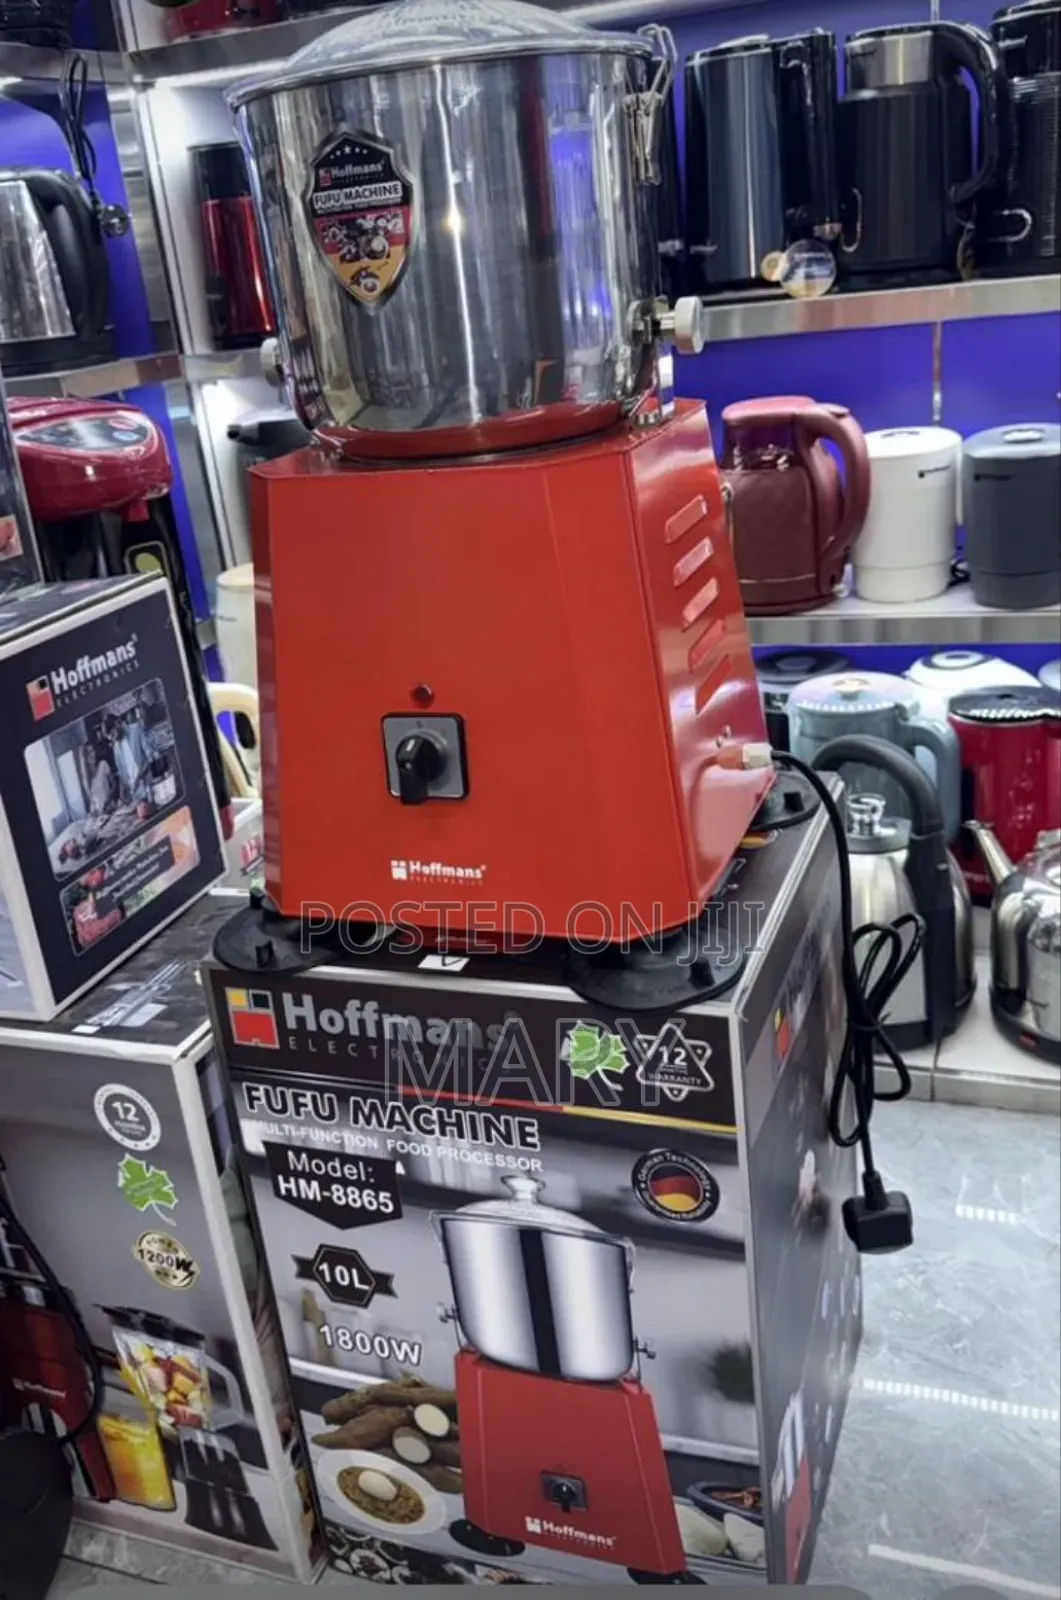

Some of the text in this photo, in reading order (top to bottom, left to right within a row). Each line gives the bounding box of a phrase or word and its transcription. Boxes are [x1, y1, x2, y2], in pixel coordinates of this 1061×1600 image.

[342, 180, 402, 204] MACHINE
[50, 640, 137, 695] Hoffmans
[409, 860, 483, 879] Hoffmans
[282, 992, 510, 1053] Hoffmans
[659, 1046, 688, 1066] 12
[111, 1101, 140, 1121] 12
[242, 1082, 541, 1152] FUFU MACHINE
[287, 1150, 375, 1183] Model:
[386, 1139, 431, 1157] FOOD
[436, 1146, 543, 1172] PROCESSOR
[278, 1174, 394, 1213] HM-8865
[138, 1248, 192, 1272] 1200W
[319, 1261, 369, 1290] 10L
[319, 1324, 421, 1366] 1800W
[542, 1519, 614, 1546] Hoffmans
